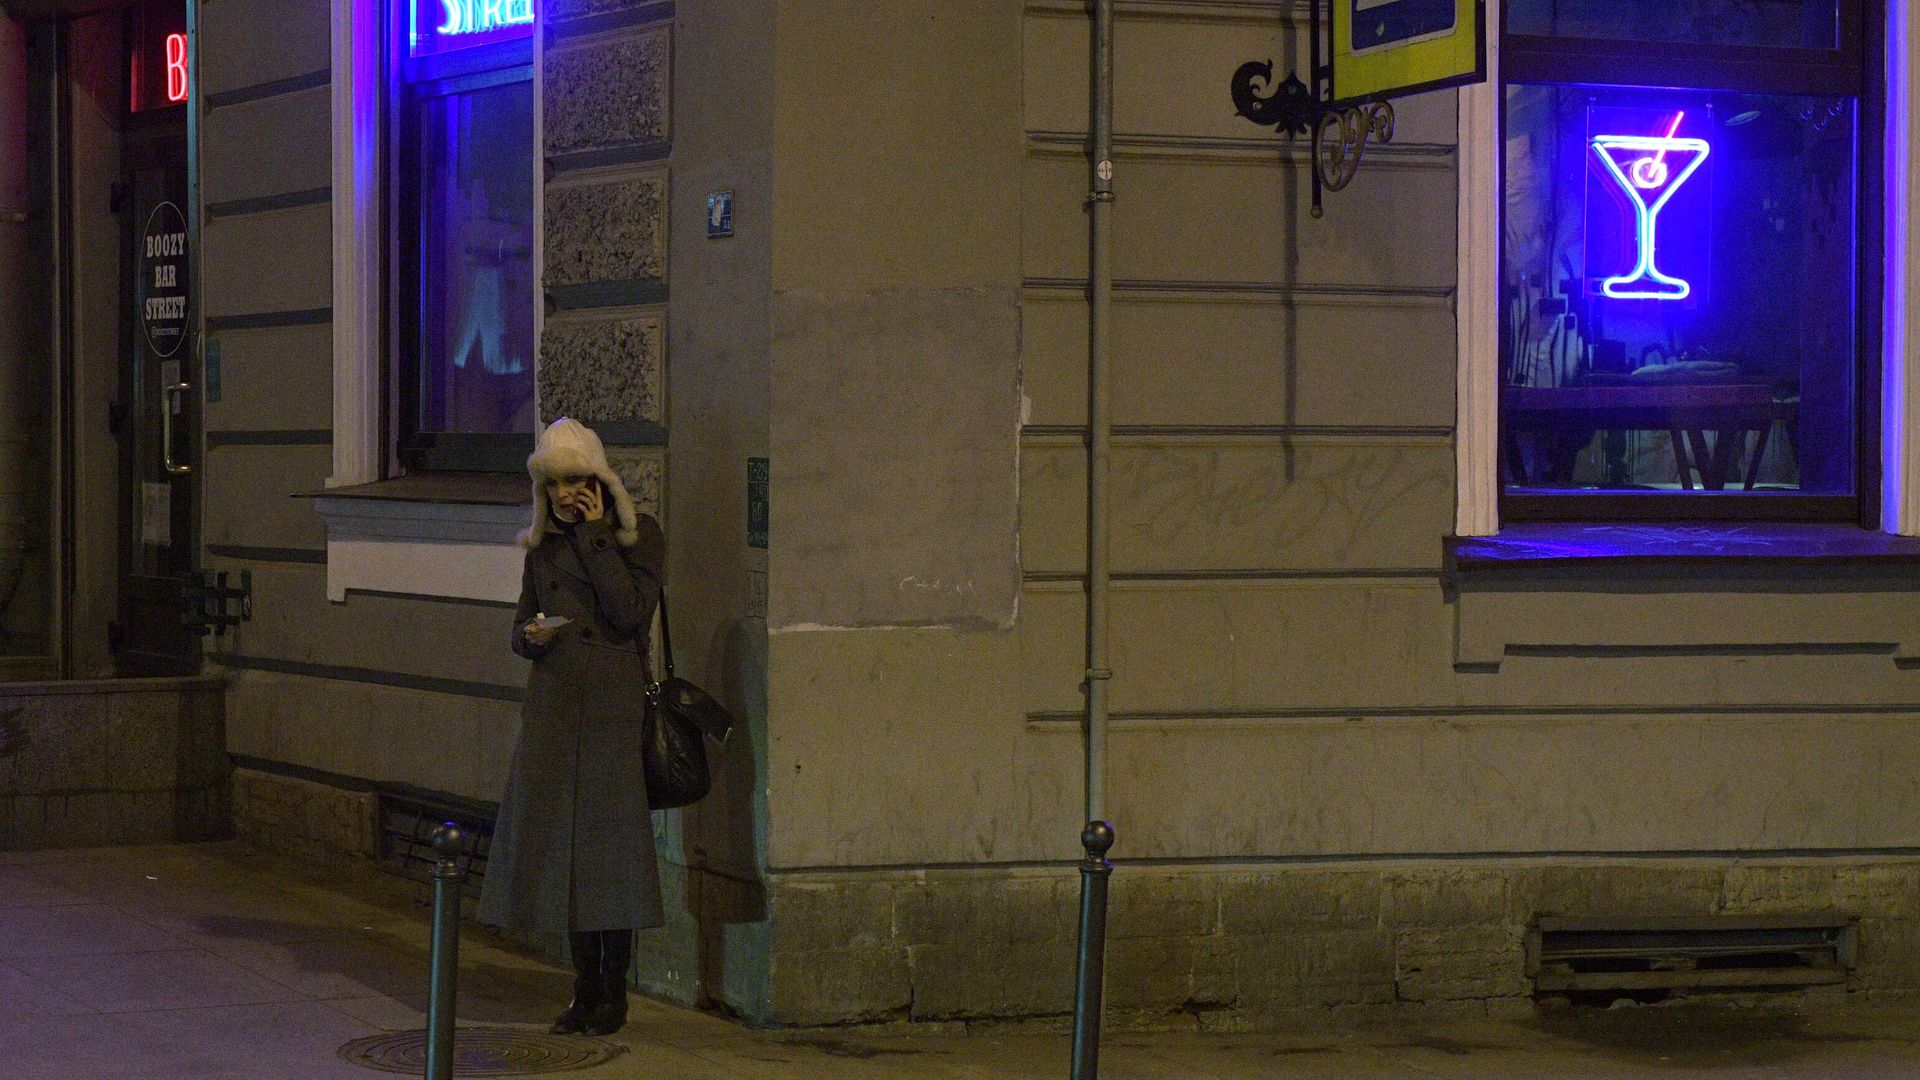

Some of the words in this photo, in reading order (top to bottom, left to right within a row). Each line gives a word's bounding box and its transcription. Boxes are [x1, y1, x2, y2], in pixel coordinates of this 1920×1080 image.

[147, 233, 185, 258] BOOZY
[155, 265, 177, 287] BAR
[146, 296, 186, 320] STREET
